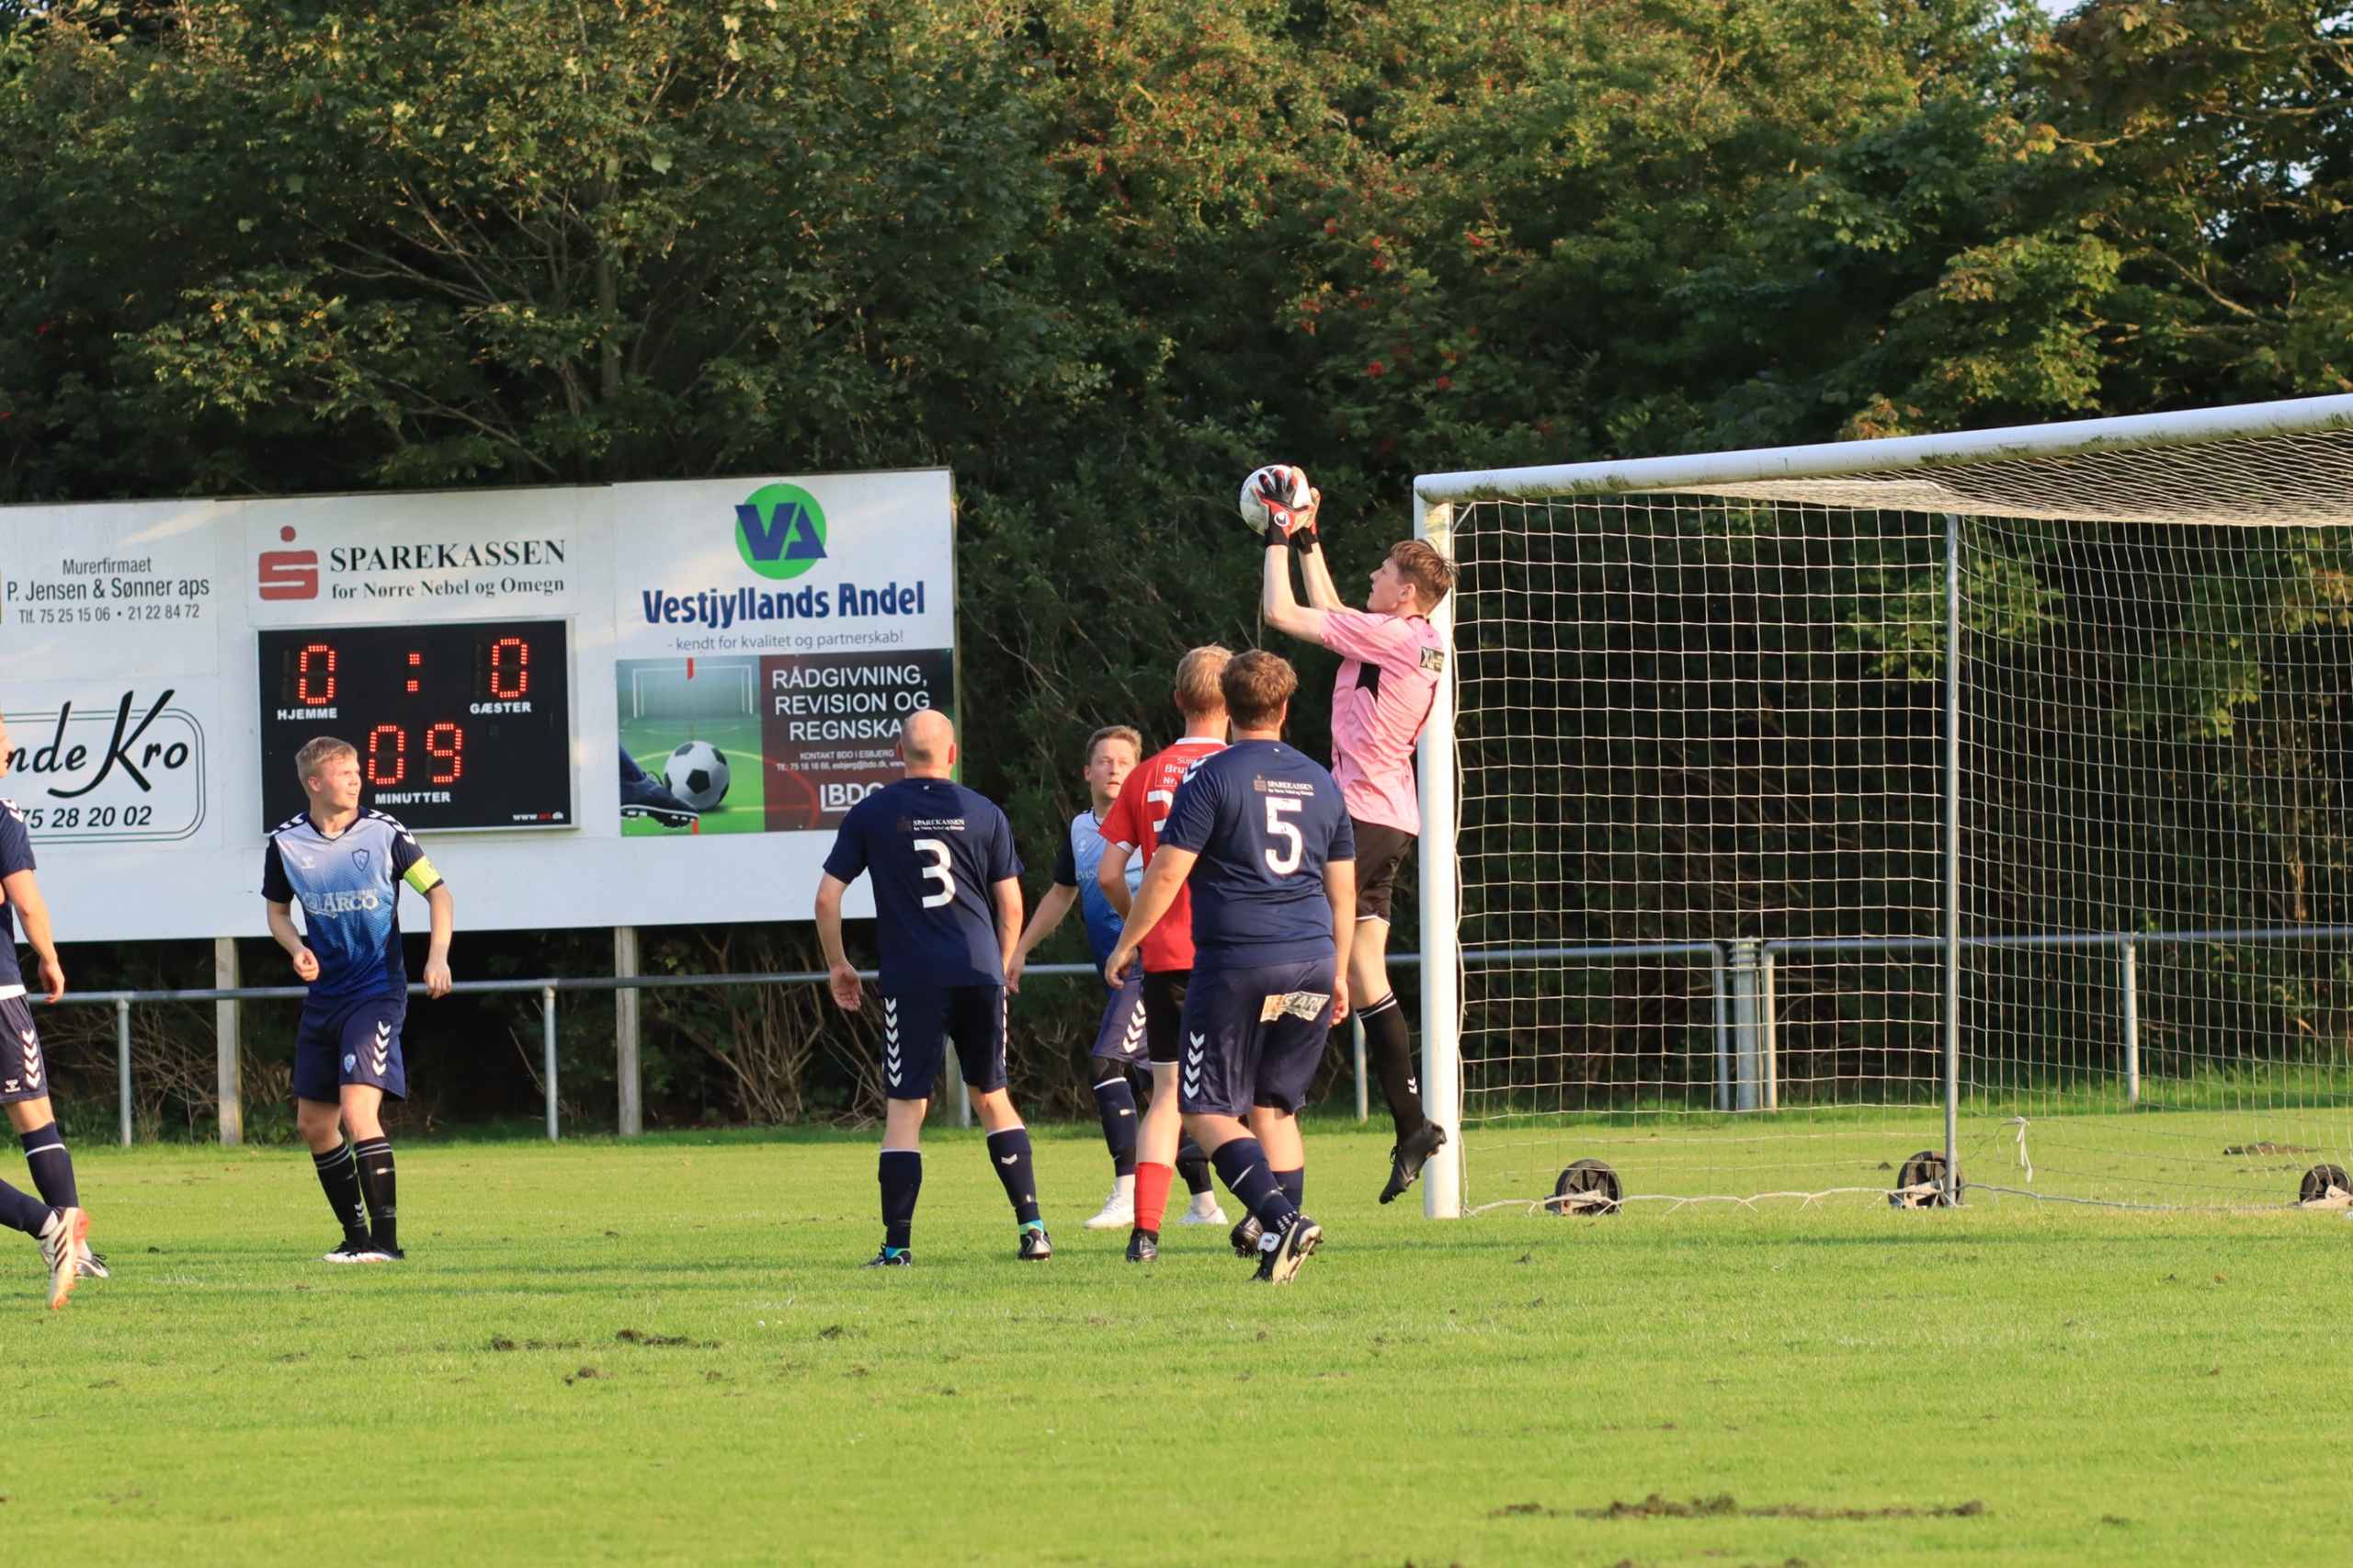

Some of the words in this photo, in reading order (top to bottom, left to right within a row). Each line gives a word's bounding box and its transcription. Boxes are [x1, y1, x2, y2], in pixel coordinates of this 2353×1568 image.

[735, 502, 827, 562] VA
[63, 557, 152, 575] Murerfirmaet
[330, 540, 565, 573] SPAREKASSEN
[6, 581, 19, 602] P.
[26, 580, 86, 601] Jensen
[93, 578, 105, 598] &
[111, 576, 173, 598] Sønner
[178, 577, 210, 598] aps
[332, 583, 358, 599] for
[421, 578, 470, 597] Nebel
[474, 581, 495, 597] og
[501, 576, 564, 596] Omegn
[40, 608, 54, 623] 75
[58, 608, 73, 622] 25
[79, 608, 91, 621] 15
[95, 607, 110, 621] 06
[128, 606, 142, 620] 21
[146, 605, 160, 619] 22
[165, 604, 180, 619] 84
[185, 604, 199, 619] 72
[642, 585, 830, 629] Vestjyllands
[838, 581, 925, 617] Andel
[676, 636, 715, 651] kendt
[719, 636, 738, 649] for
[741, 634, 791, 649] kvalitet
[795, 636, 813, 649] og
[816, 630, 904, 650] partnerskab!
[298, 643, 337, 705] 0
[490, 638, 529, 699] 0
[772, 665, 927, 689] RÅDGIVNING,
[277, 708, 337, 721] HJEMME
[470, 701, 531, 714] GÆSTER
[775, 692, 887, 715] REVISION
[893, 691, 930, 711] OG
[790, 718, 903, 741] REGNSKA
[6, 700, 87, 773] nde
[47, 688, 188, 799] Kro
[368, 722, 462, 785] 09
[800, 751, 835, 760] KONTAKT
[836, 750, 854, 759] BDO
[858, 749, 894, 758] ESBJERG
[375, 791, 451, 804] MINUTTER
[51, 807, 80, 828] 28
[87, 806, 116, 827] 20
[124, 805, 152, 826] 02
[1266, 796, 1302, 875] 5
[913, 838, 956, 908] 3
